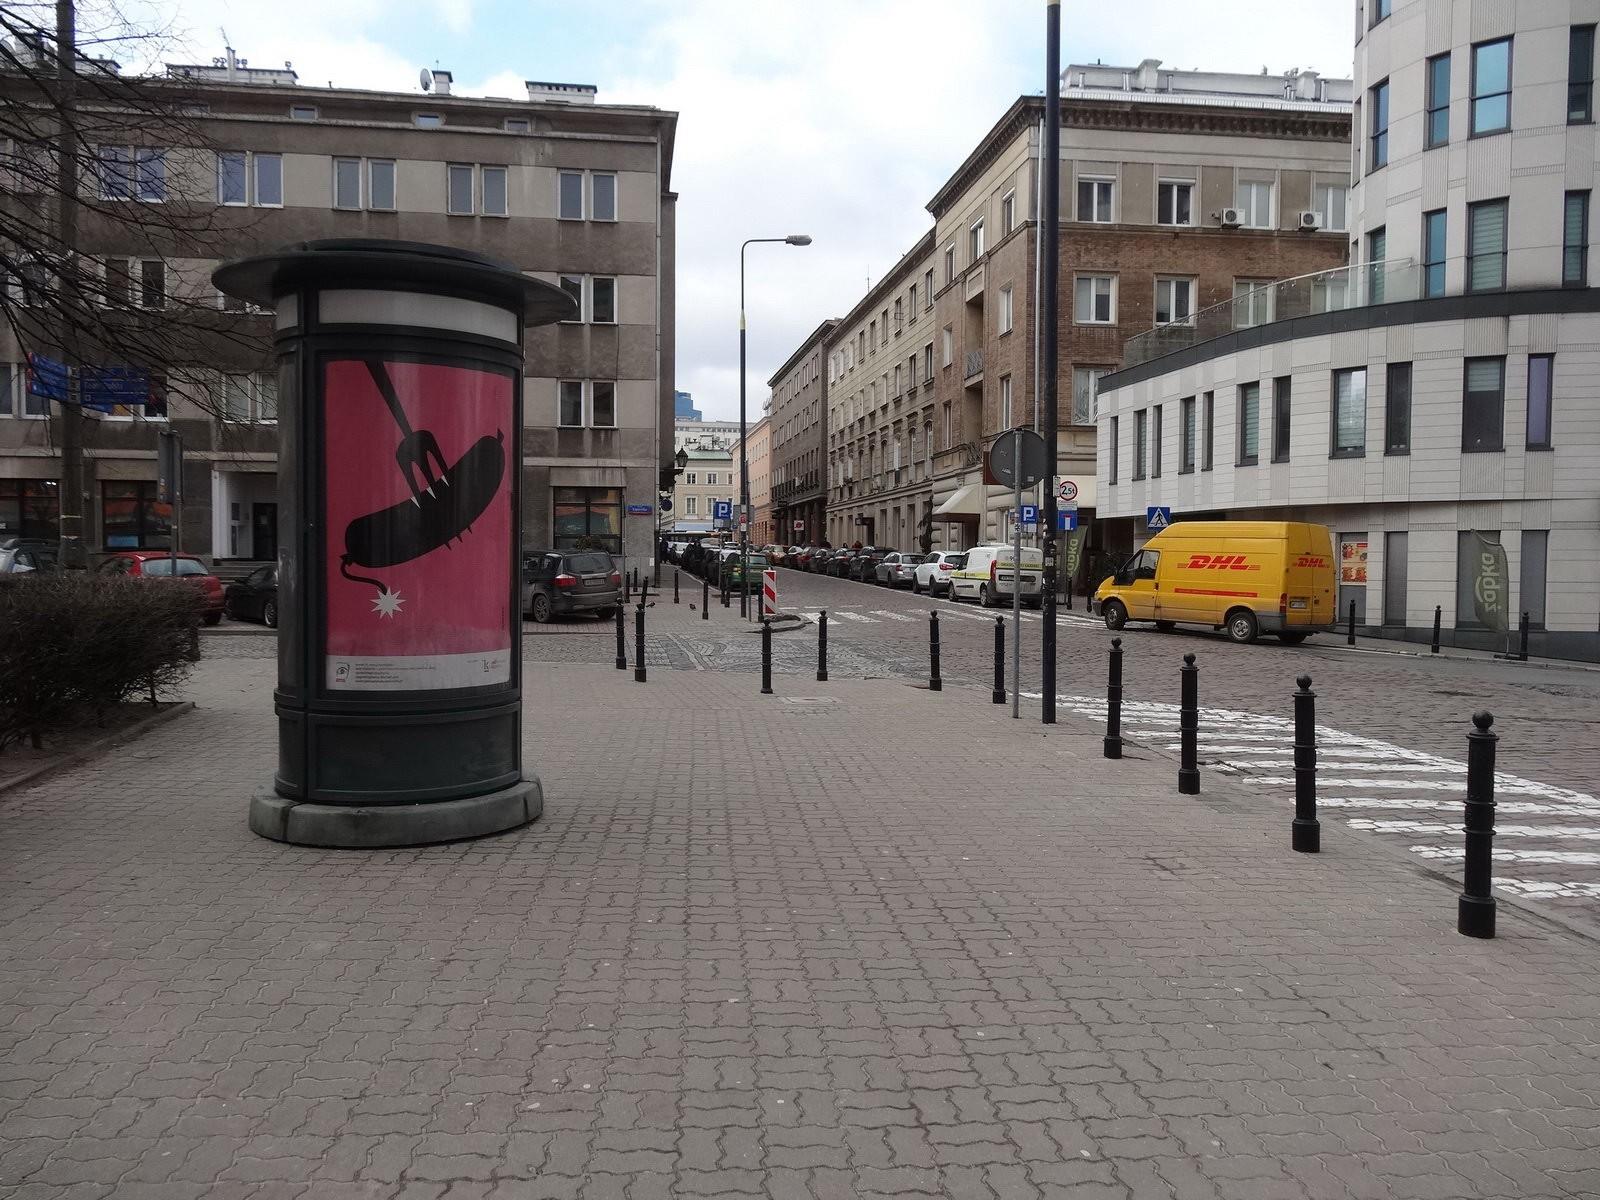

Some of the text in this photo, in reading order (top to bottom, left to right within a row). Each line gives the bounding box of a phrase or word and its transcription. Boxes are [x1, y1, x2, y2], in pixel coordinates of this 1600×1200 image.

[718, 503, 728, 517] P
[1023, 506, 1034, 521] P
[1188, 555, 1249, 570] DHL
[1298, 557, 1325, 568] DHL
